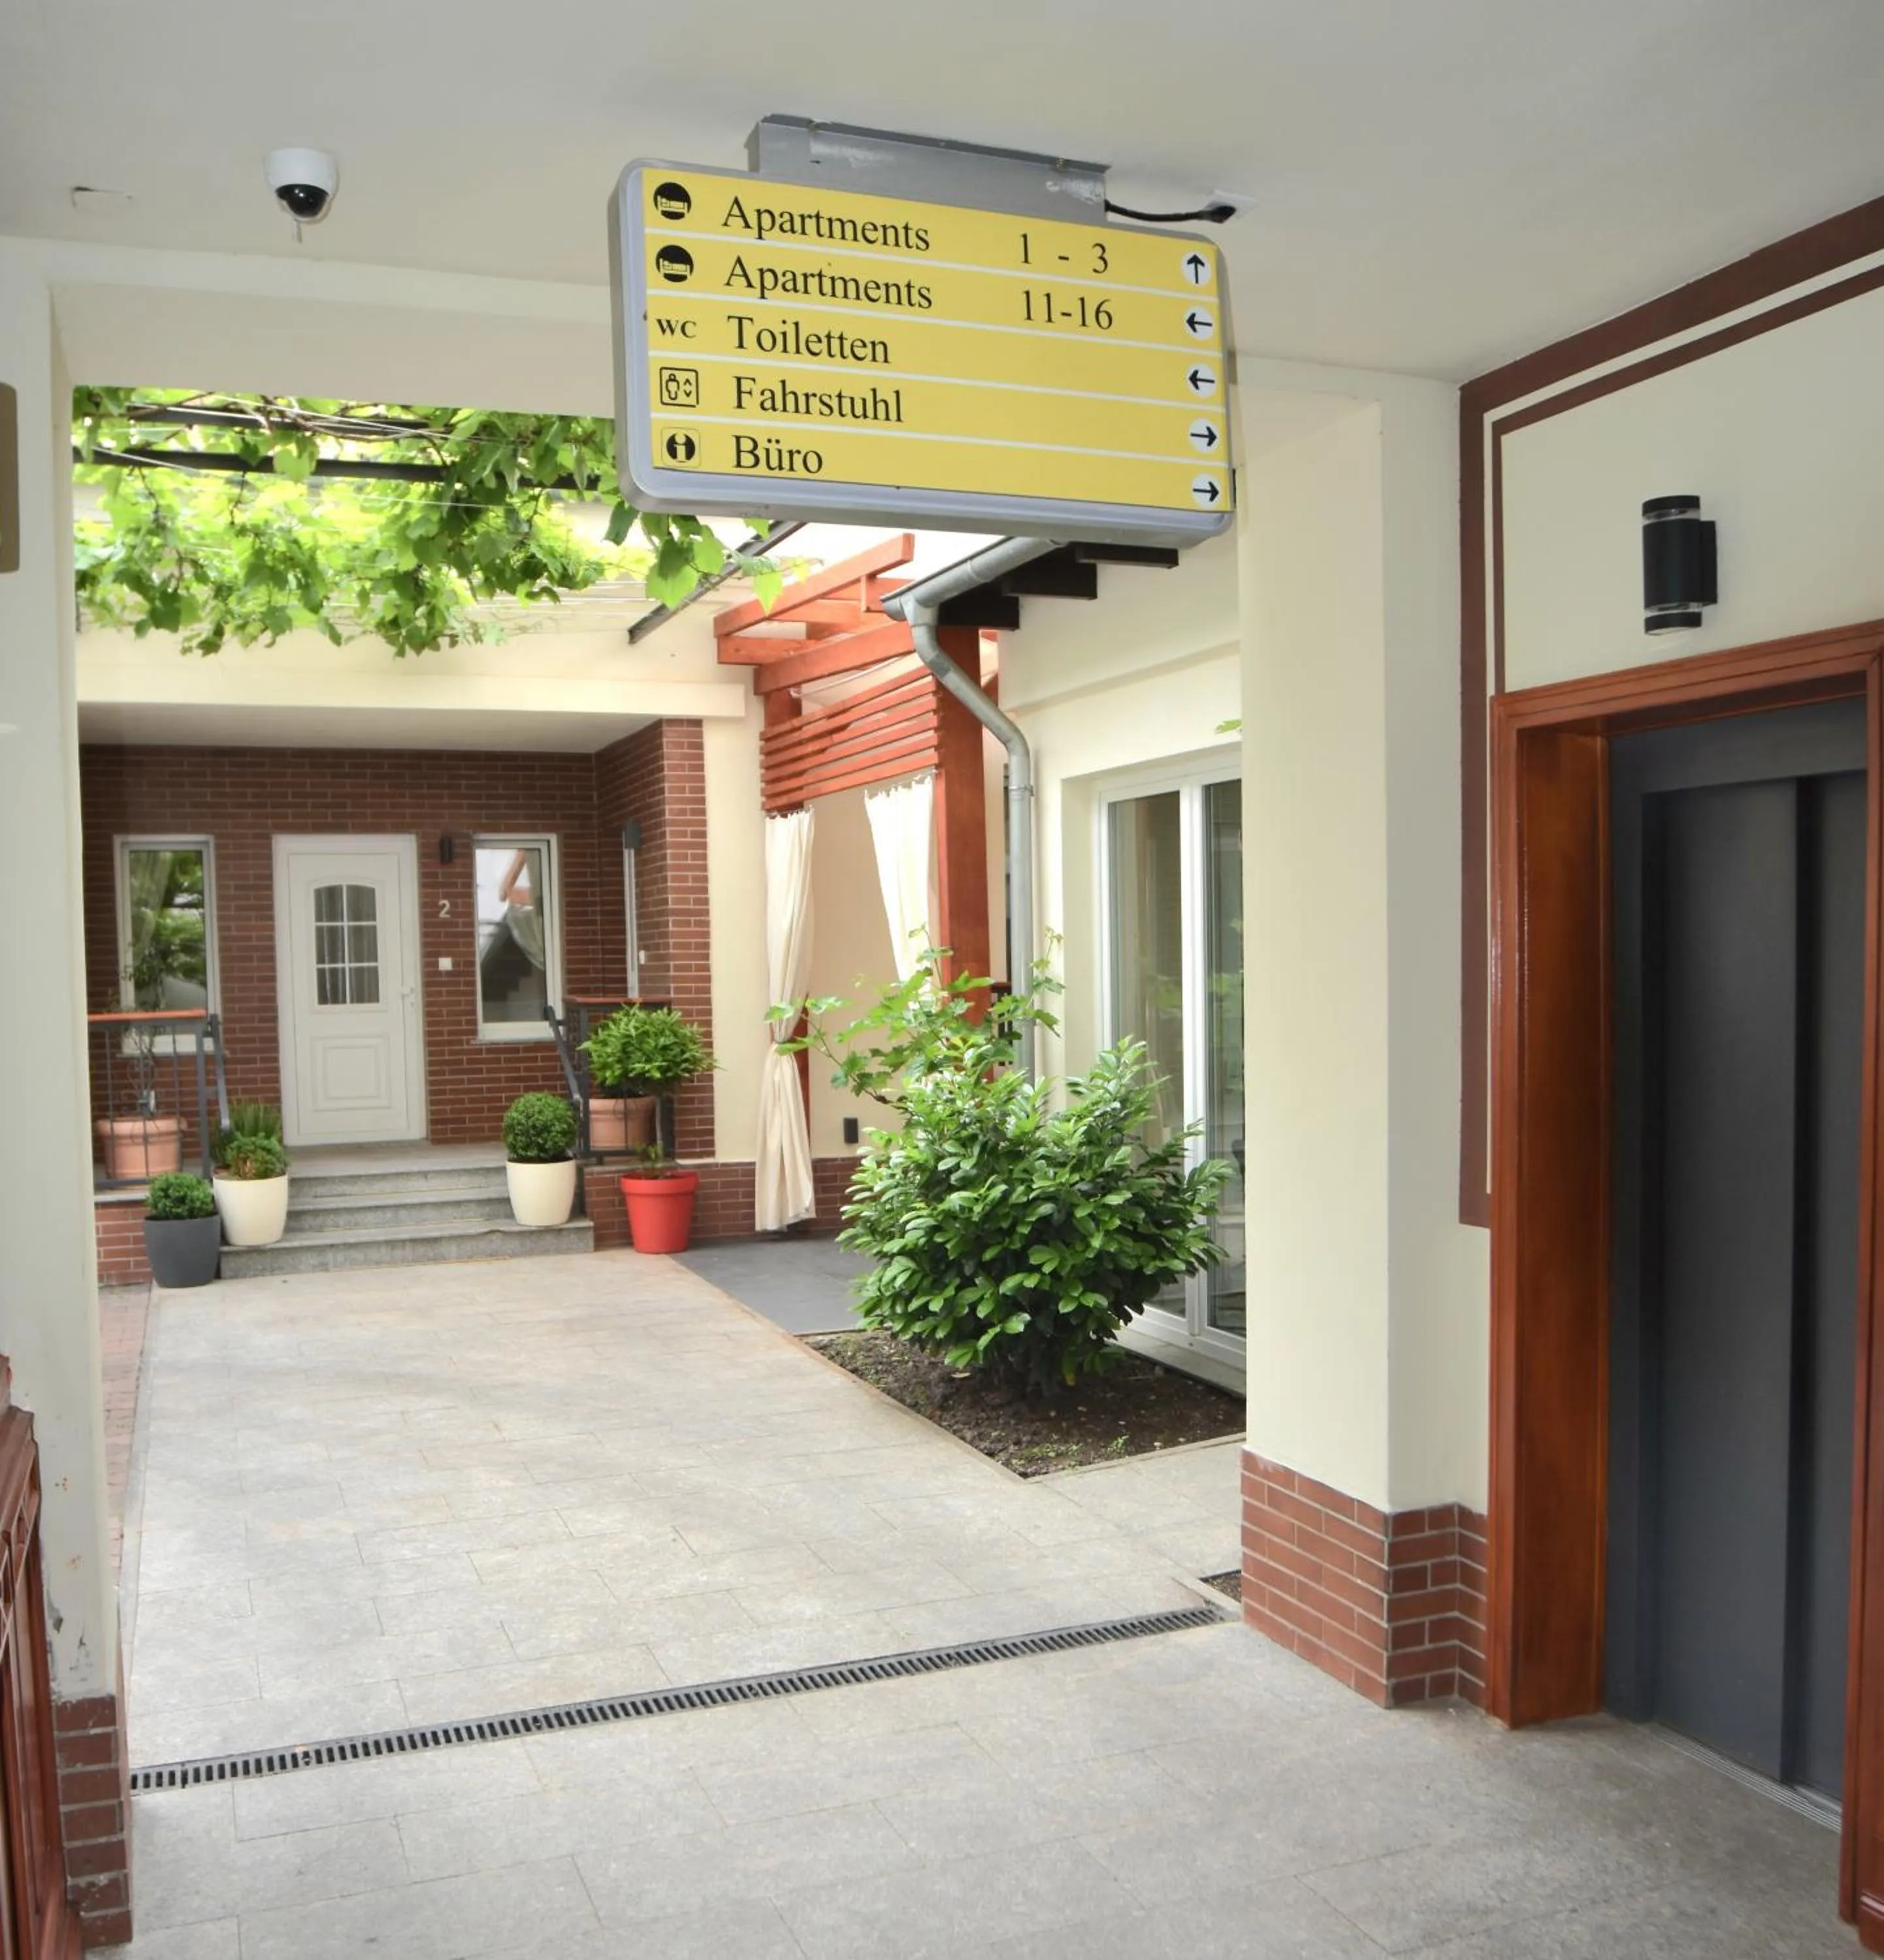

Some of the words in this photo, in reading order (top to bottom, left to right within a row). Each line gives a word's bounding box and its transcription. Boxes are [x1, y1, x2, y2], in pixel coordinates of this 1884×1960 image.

[722, 196, 930, 252] Apartments
[1020, 233, 1030, 264] 1
[1092, 242, 1109, 274] 3
[724, 255, 933, 309] Apartments
[1023, 290, 1113, 330] 11-16
[726, 316, 890, 364] Toiletten
[733, 376, 904, 423] Fahrstuhl
[732, 434, 823, 474] Büro
[438, 899, 451, 918] 2
